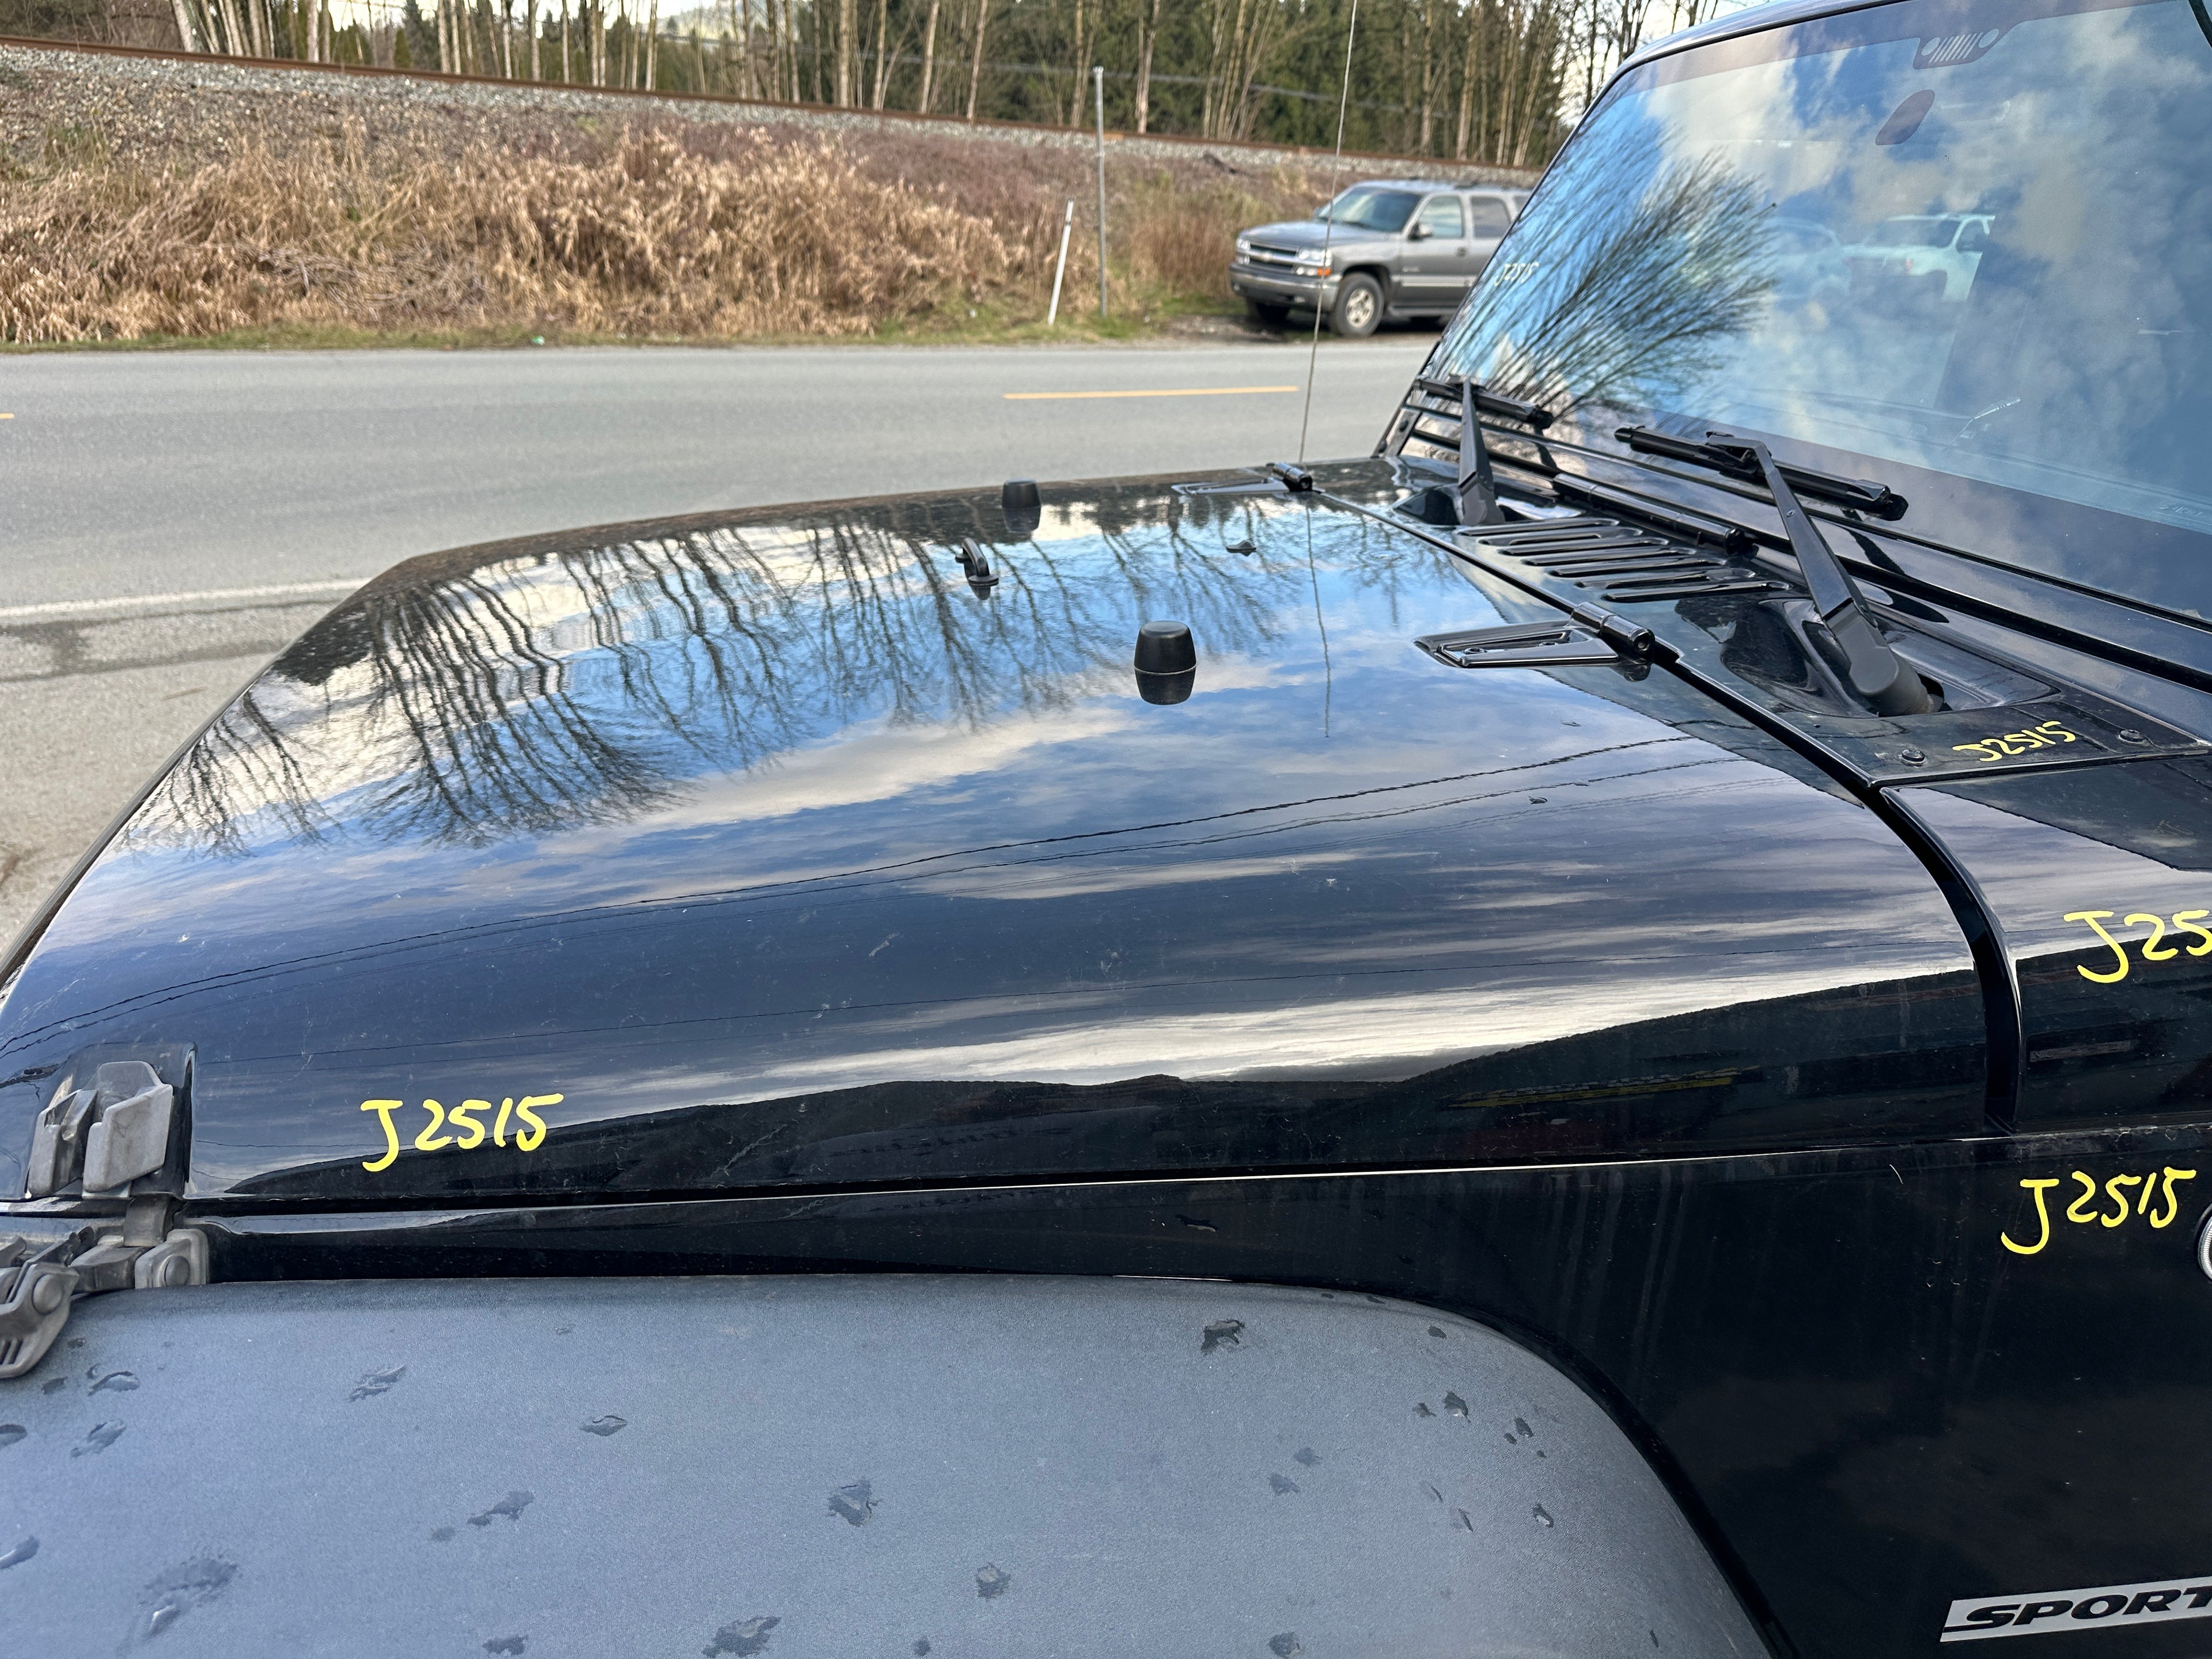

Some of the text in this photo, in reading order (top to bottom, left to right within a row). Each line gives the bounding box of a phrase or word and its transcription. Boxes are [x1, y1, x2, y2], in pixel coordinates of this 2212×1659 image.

[360, 1093, 565, 1172] J2515
[2001, 1166, 2197, 1255] J2515
[1943, 1586, 2212, 1633] SPORT
